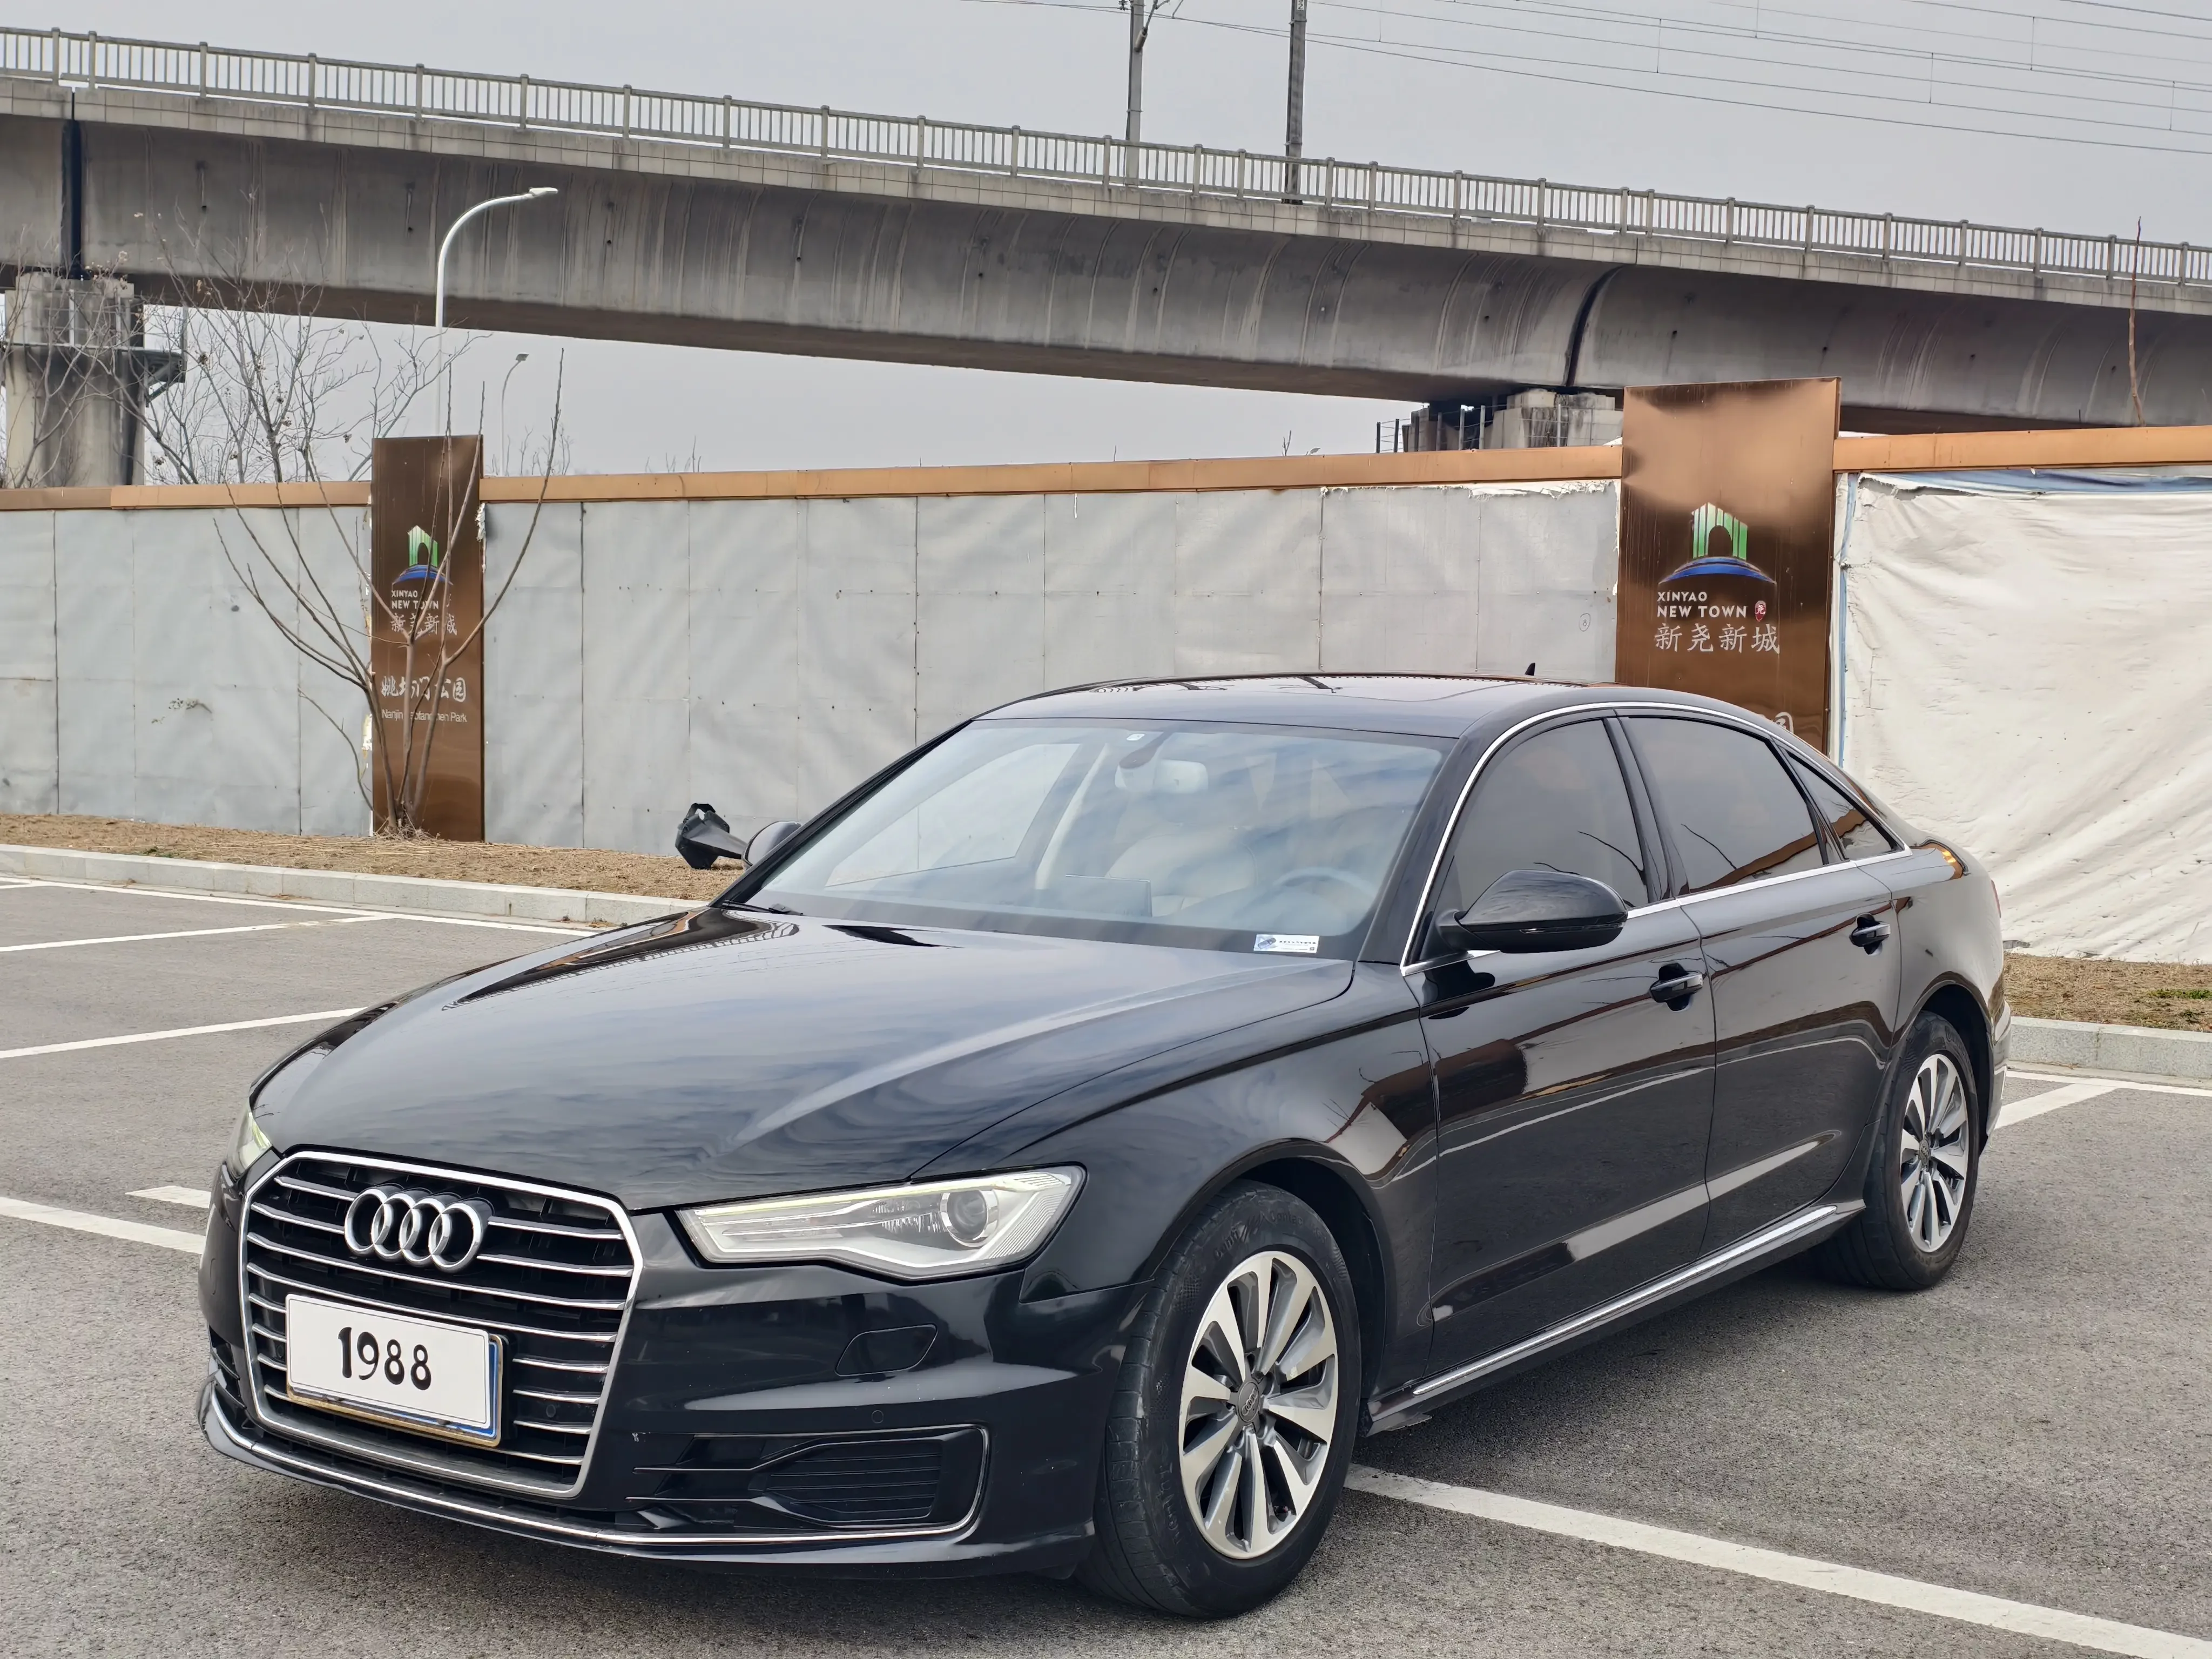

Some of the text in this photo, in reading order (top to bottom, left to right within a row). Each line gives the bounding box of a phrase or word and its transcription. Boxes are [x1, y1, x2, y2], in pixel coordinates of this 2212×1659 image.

[392, 590, 418, 598] XINYAO
[1657, 591, 1708, 602] XINYAO
[392, 601, 410, 609] NEW
[1657, 605, 1748, 618] NEW TOWN
[1654, 623, 1780, 654] 新尧新城
[382, 709, 404, 721] Nanjin
[450, 712, 468, 723] Park
[338, 1327, 431, 1391] 1988
